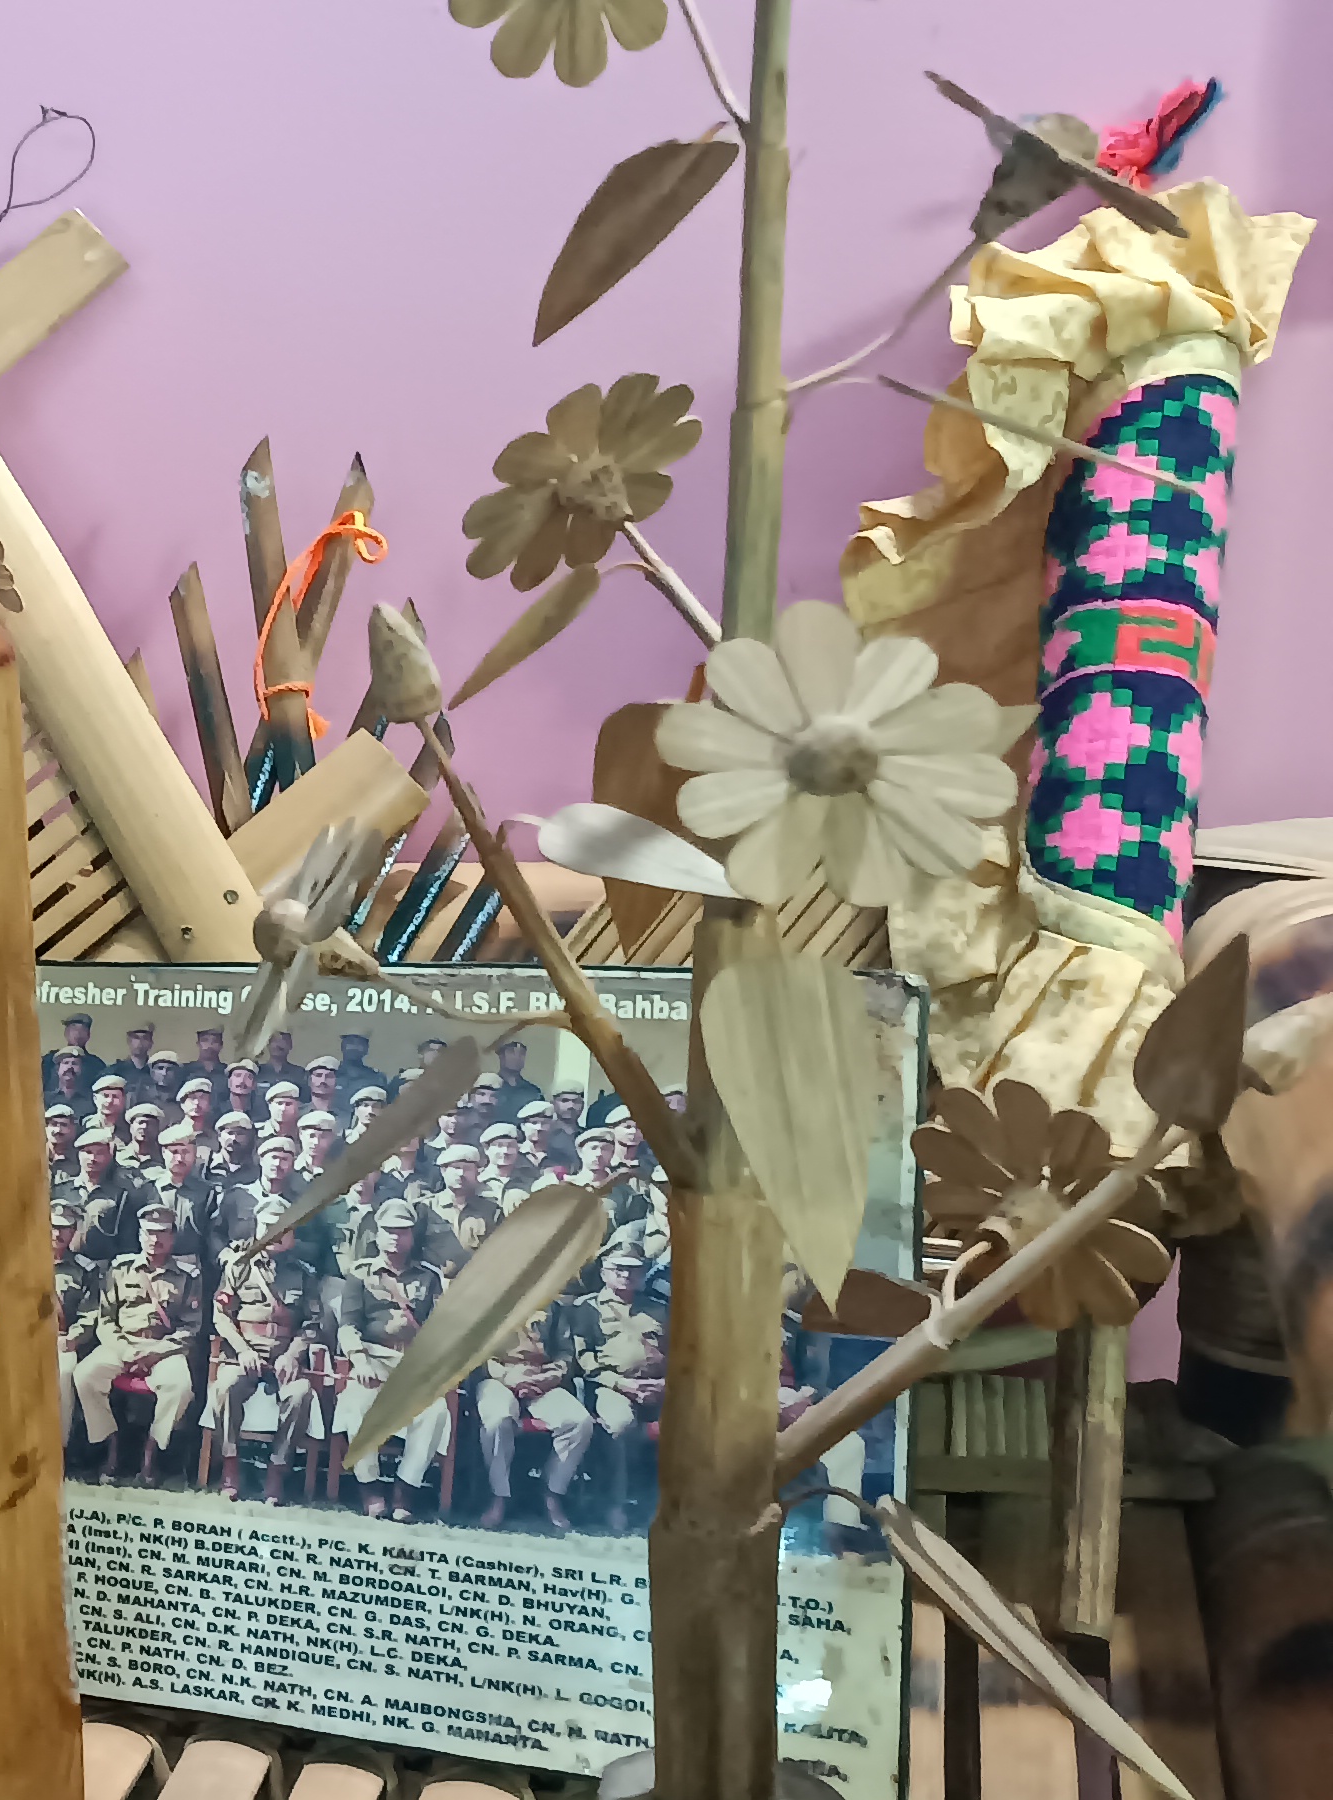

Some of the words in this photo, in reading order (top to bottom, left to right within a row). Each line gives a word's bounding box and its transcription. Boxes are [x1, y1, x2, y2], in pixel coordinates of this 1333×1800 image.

[36, 980, 127, 1007] fresher
[133, 983, 234, 1015] Training
[346, 988, 418, 1014] 2014.
[116, 1513, 147, 1527] P/C.
[153, 1517, 165, 1529] P.
[317, 1538, 351, 1552] P/C.
[357, 1542, 375, 1555] K.
[455, 1555, 544, 1579] (Cashier),
[551, 1566, 583, 1581] SRI
[591, 1571, 627, 1587] L.R.
[137, 1548, 165, 1561] CN.
[172, 1552, 190, 1565] M.
[196, 1555, 270, 1577] MURARI,
[276, 1565, 306, 1579] CN.
[313, 1570, 332, 1583] M.
[338, 1573, 452, 1600] BORDOALOI,
[458, 1589, 490, 1603] CN.
[498, 1594, 515, 1607] D.
[522, 1597, 610, 1621] BHUYAN,
[139, 1532, 188, 1550] NK(H)
[194, 1538, 263, 1559] B.DEKA,
[269, 1548, 299, 1562] CN.
[306, 1553, 322, 1565] R.
[329, 1556, 383, 1575] NATH,
[427, 1567, 441, 1580] T.
[448, 1570, 536, 1594] BARMAN,
[543, 1583, 612, 1603] Hav(H).
[620, 1592, 640, 1605] G.
[94, 1574, 159, 1595] HOQUE,
[164, 1583, 193, 1597] CN.
[199, 1587, 216, 1601] B.
[221, 1591, 321, 1616] TALUKDER,
[327, 1605, 357, 1619] CN.
[364, 1610, 382, 1623] G.
[389, 1613, 430, 1632] DAS,
[437, 1620, 468, 1635] CN.
[475, 1625, 495, 1638] G.
[502, 1629, 559, 1647] DEKA.
[96, 1590, 111, 1602] D.
[117, 1593, 205, 1617] MAHANTA,
[211, 1606, 241, 1620] CN.
[247, 1610, 259, 1622] P.
[266, 1613, 320, 1633] DEKA,
[326, 1622, 357, 1636] CN.
[363, 1627, 398, 1642] S.R.
[405, 1632, 461, 1653] NATH,
[467, 1641, 499, 1656] CN.
[507, 1646, 521, 1659] P.
[527, 1650, 602, 1672] SARMA,
[610, 1661, 643, 1676] CN.
[106, 1559, 134, 1573] CN.
[140, 1564, 156, 1576] R.
[162, 1567, 238, 1589] SARKAR,
[243, 1578, 273, 1591] CN.
[279, 1582, 315, 1597] H.R.
[321, 1587, 432, 1615] MAZUMDER,
[439, 1603, 515, 1625] L/NK(H).
[522, 1614, 541, 1627] N.
[548, 1618, 625, 1641] ORANG,
[79, 1604, 107, 1618] CN.
[113, 1608, 127, 1620] S.
[133, 1611, 165, 1627] ALI,
[171, 1616, 200, 1631] CN.
[206, 1621, 240, 1636] D.K.
[246, 1627, 299, 1647] NATH,
[306, 1635, 363, 1655] NK(H).
[369, 1644, 403, 1659] L.C.
[411, 1650, 467, 1671] DEKA,
[82, 1619, 177, 1645] TALUKDER,
[182, 1634, 211, 1648] CN.
[217, 1639, 234, 1652] R.
[240, 1642, 340, 1669] HANDIQUE,
[346, 1658, 377, 1673] CN.
[384, 1663, 401, 1676] S.
[407, 1666, 463, 1687] NATH,
[470, 1676, 548, 1699] L/NK(H).
[86, 1636, 115, 1651] CN.
[121, 1641, 133, 1653] P.
[196, 1652, 225, 1667] CN.
[231, 1657, 247, 1671] D.
[254, 1661, 293, 1677] BEZ.
[106, 1656, 121, 1668] S.
[127, 1658, 180, 1679] BORO,
[186, 1667, 215, 1682] CN.
[221, 1672, 257, 1689] N.K.
[263, 1679, 317, 1700] NATH,
[323, 1688, 353, 1703] CN.
[360, 1694, 378, 1707] A.
[131, 1676, 163, 1691] A.S.
[170, 1681, 244, 1705] LASKAR,
[286, 1699, 305, 1713] K.
[311, 1703, 376, 1726] MEDHI,
[382, 1714, 415, 1730] NK.
[421, 1721, 440, 1733] G.
